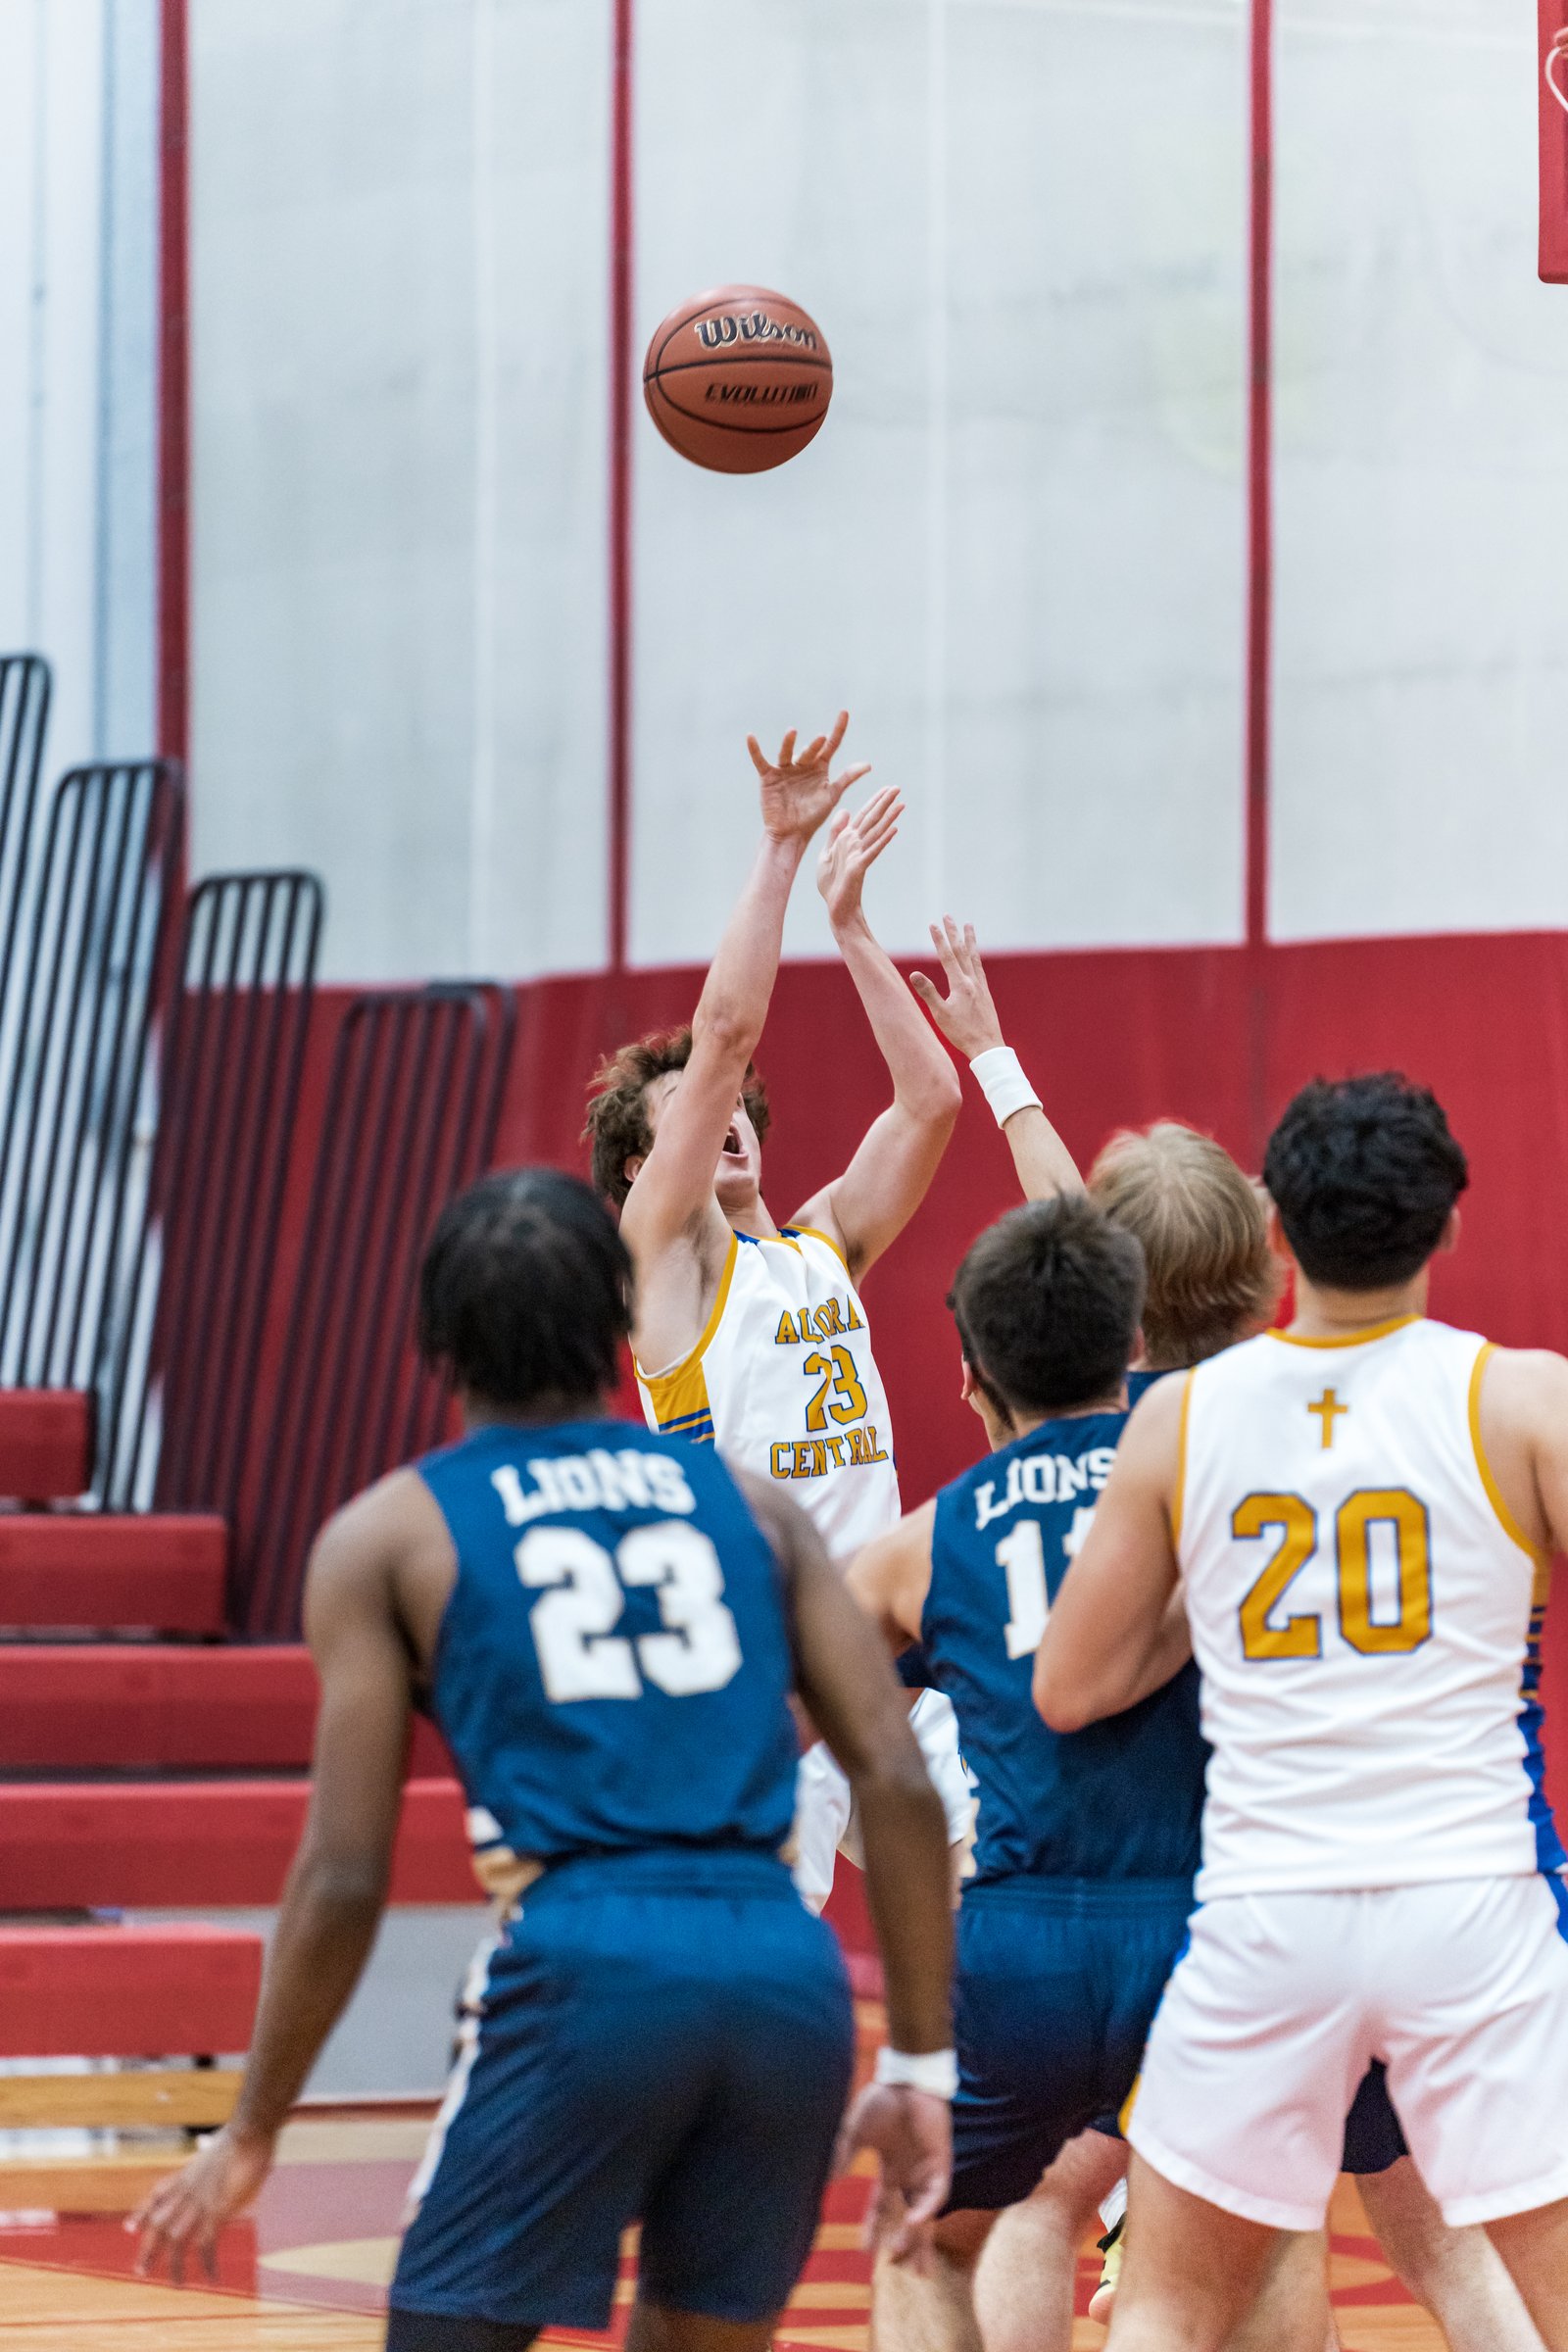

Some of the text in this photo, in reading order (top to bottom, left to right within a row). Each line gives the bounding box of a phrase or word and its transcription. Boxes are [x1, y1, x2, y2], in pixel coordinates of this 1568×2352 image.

[694, 310, 818, 352] Wilson
[803, 1344, 868, 1433] 23
[491, 1447, 697, 1528] LIONS
[769, 1425, 889, 1479] CENTRAL
[974, 1446, 1118, 1531] LIONS
[514, 1518, 743, 1705] 23
[995, 1504, 1099, 1661] 1
[1230, 1486, 1434, 1662] 20
